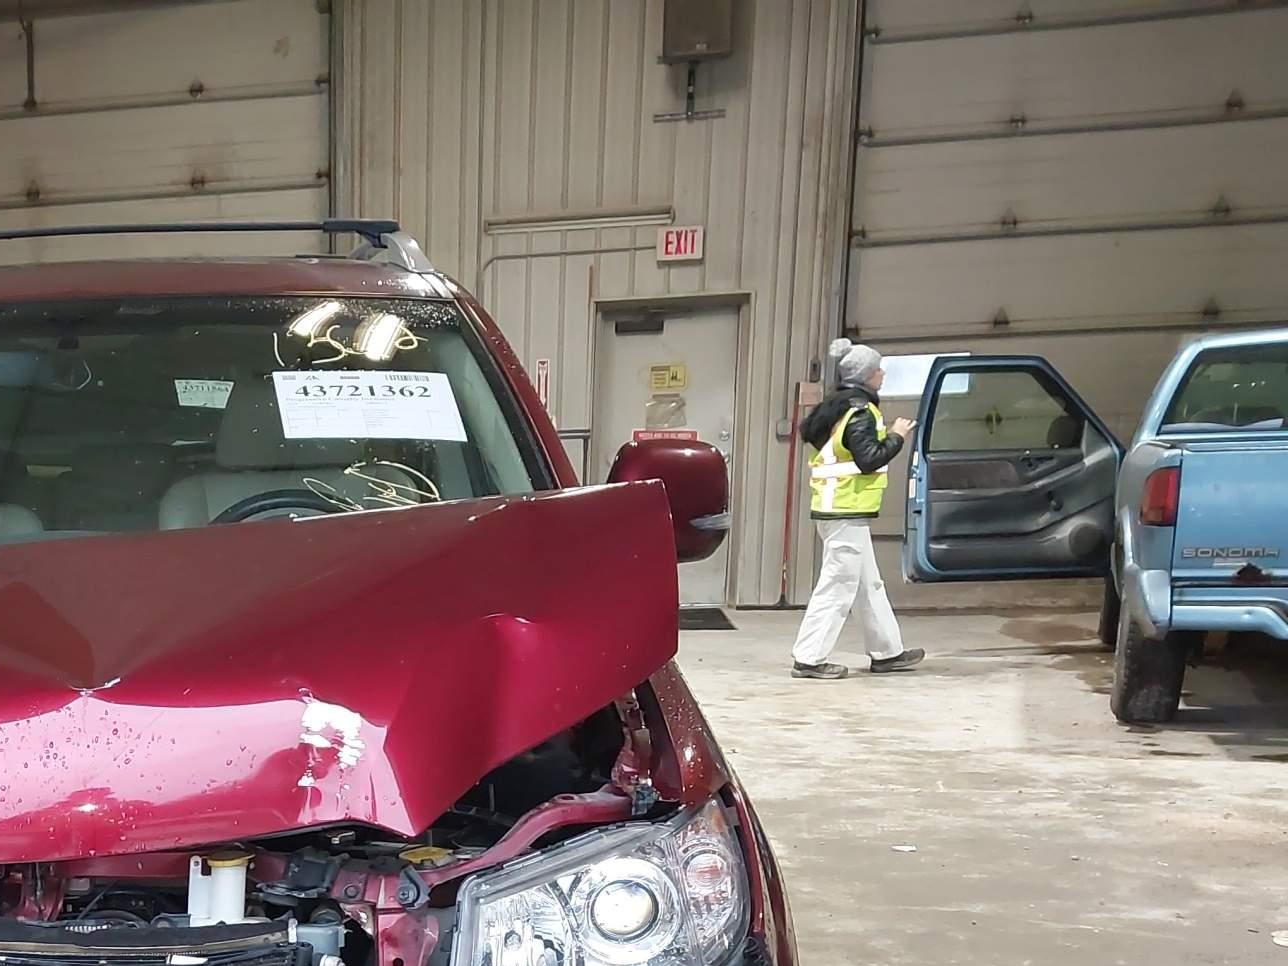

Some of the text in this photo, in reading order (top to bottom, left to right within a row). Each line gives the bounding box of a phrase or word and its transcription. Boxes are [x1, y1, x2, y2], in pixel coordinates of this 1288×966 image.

[665, 229, 697, 255] EXIT
[295, 385, 431, 398] 43721362
[1182, 546, 1280, 558] SONOMA
